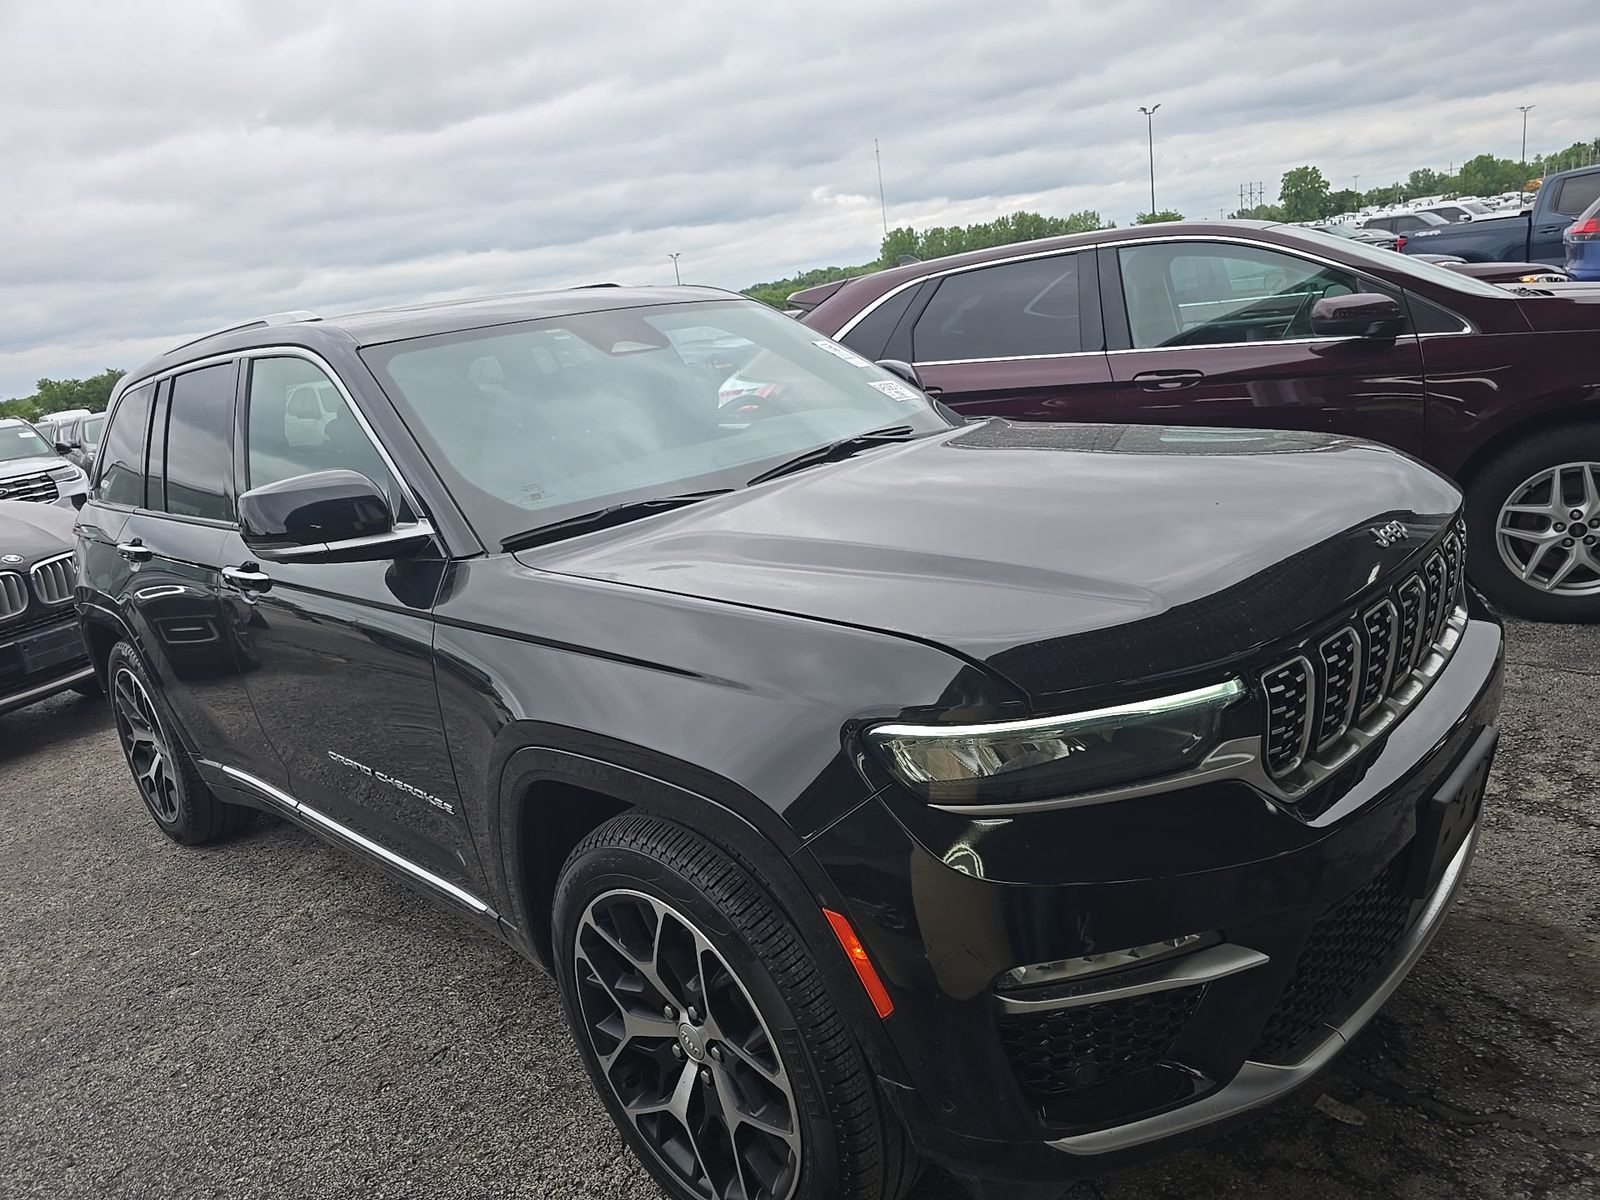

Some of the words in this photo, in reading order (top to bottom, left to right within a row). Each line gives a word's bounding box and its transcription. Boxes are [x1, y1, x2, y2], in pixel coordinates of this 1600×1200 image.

[1370, 519, 1409, 548] Jeep
[328, 750, 373, 776] GRAND
[375, 771, 456, 815] CHEROKEE
